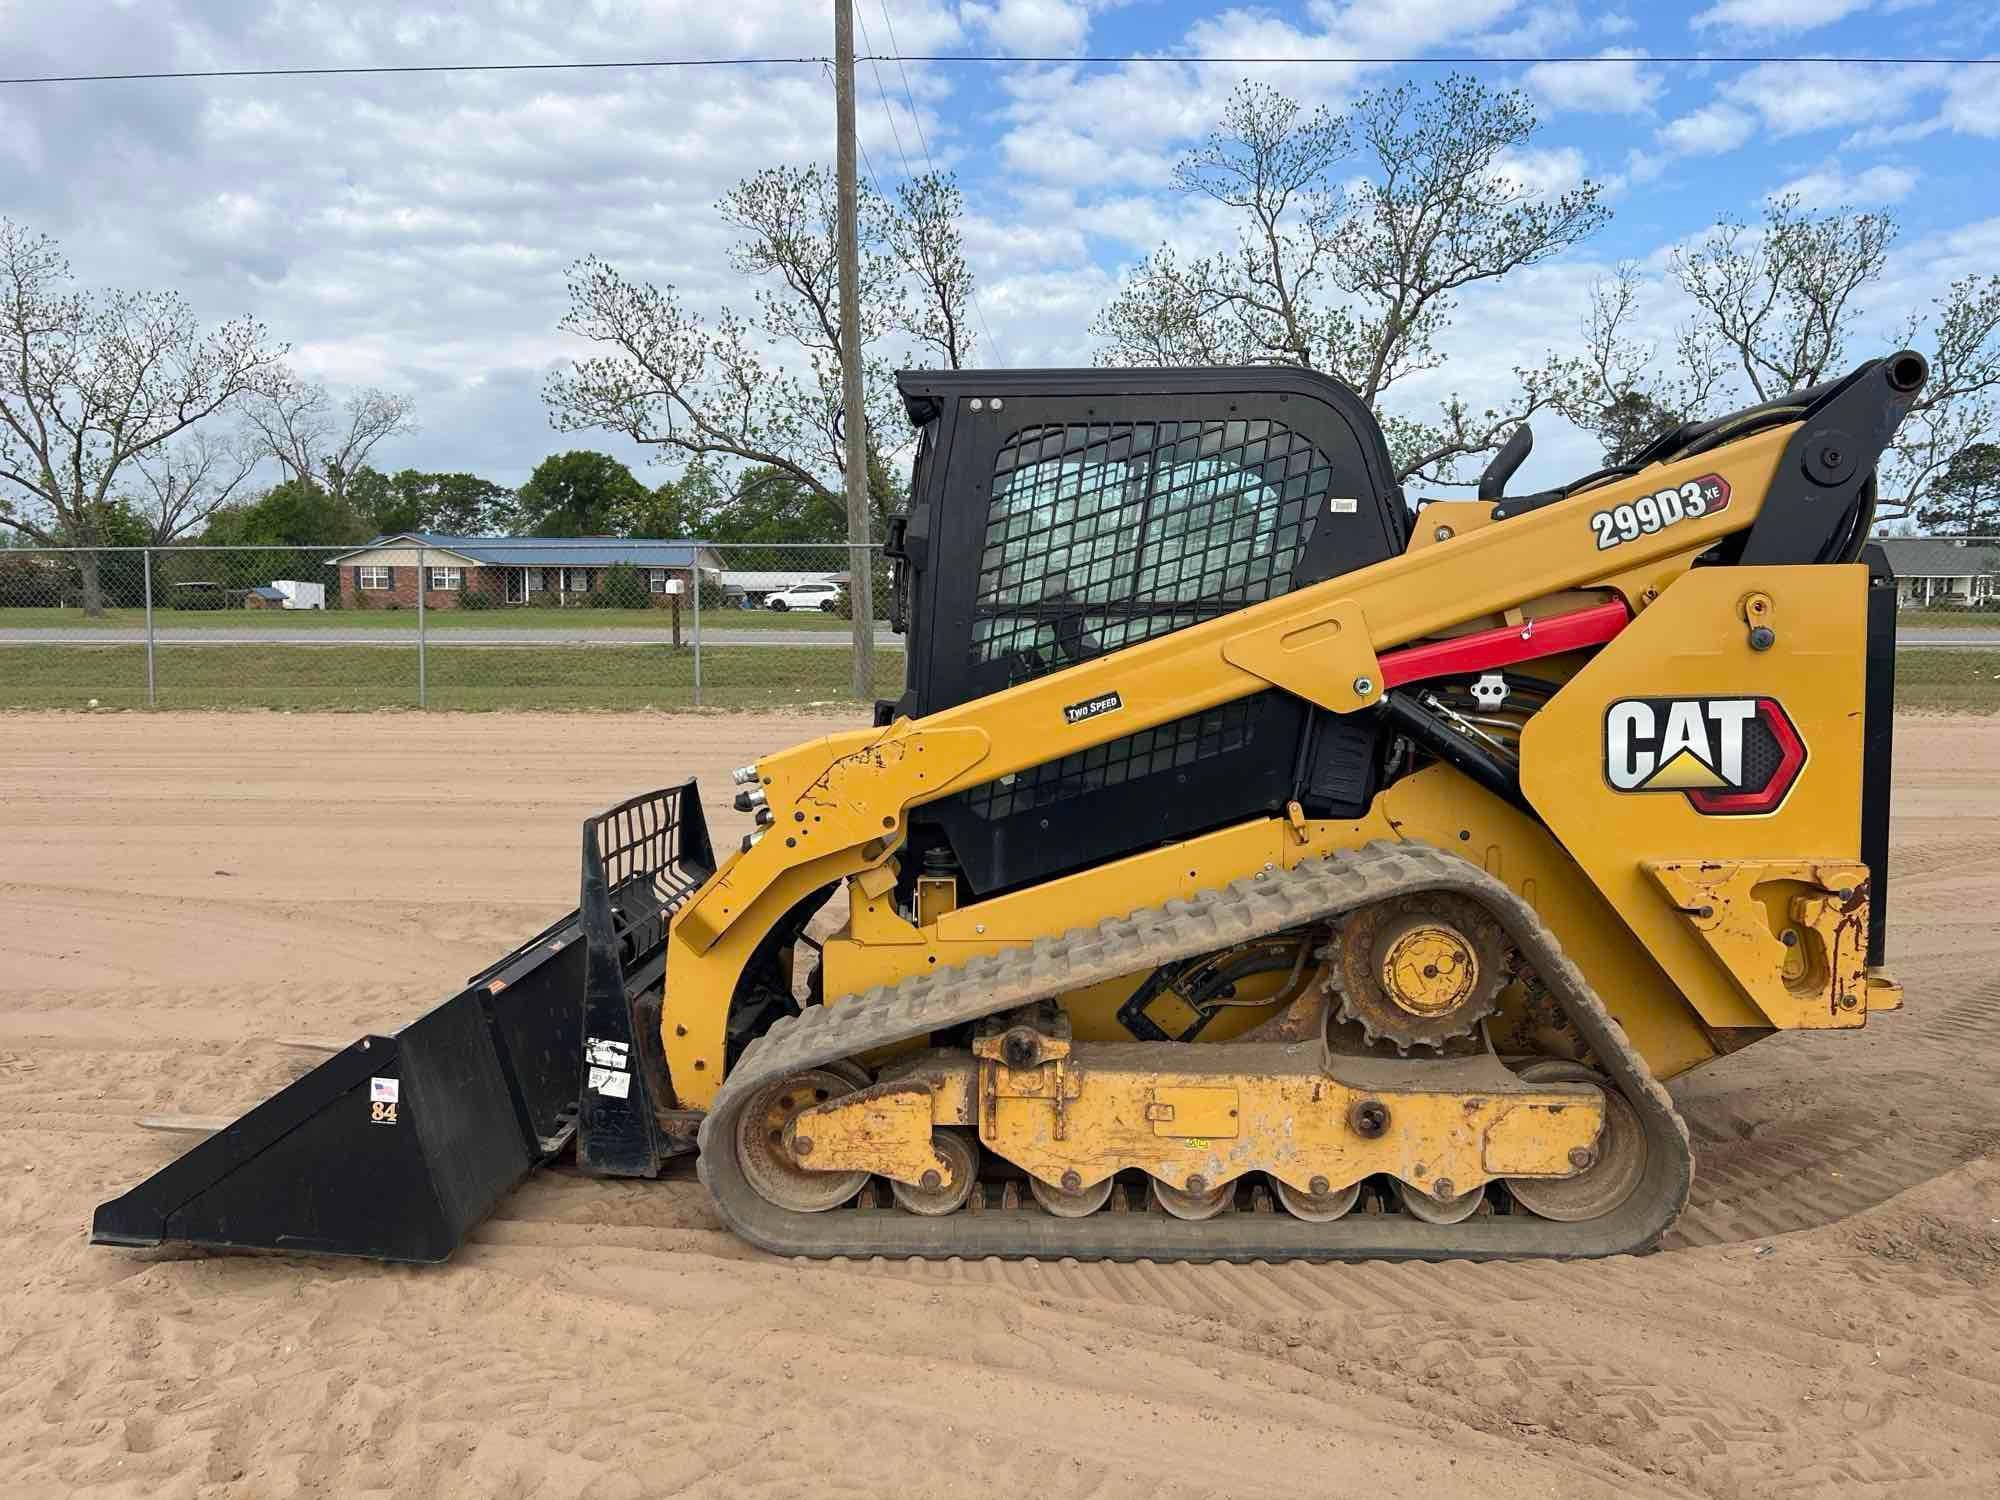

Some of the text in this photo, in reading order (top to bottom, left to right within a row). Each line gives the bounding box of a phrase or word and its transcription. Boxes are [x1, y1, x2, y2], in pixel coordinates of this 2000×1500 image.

[1591, 482, 1720, 549] 299D3 XE
[1607, 700, 1756, 789] CAT
[371, 1101, 397, 1122] 84
